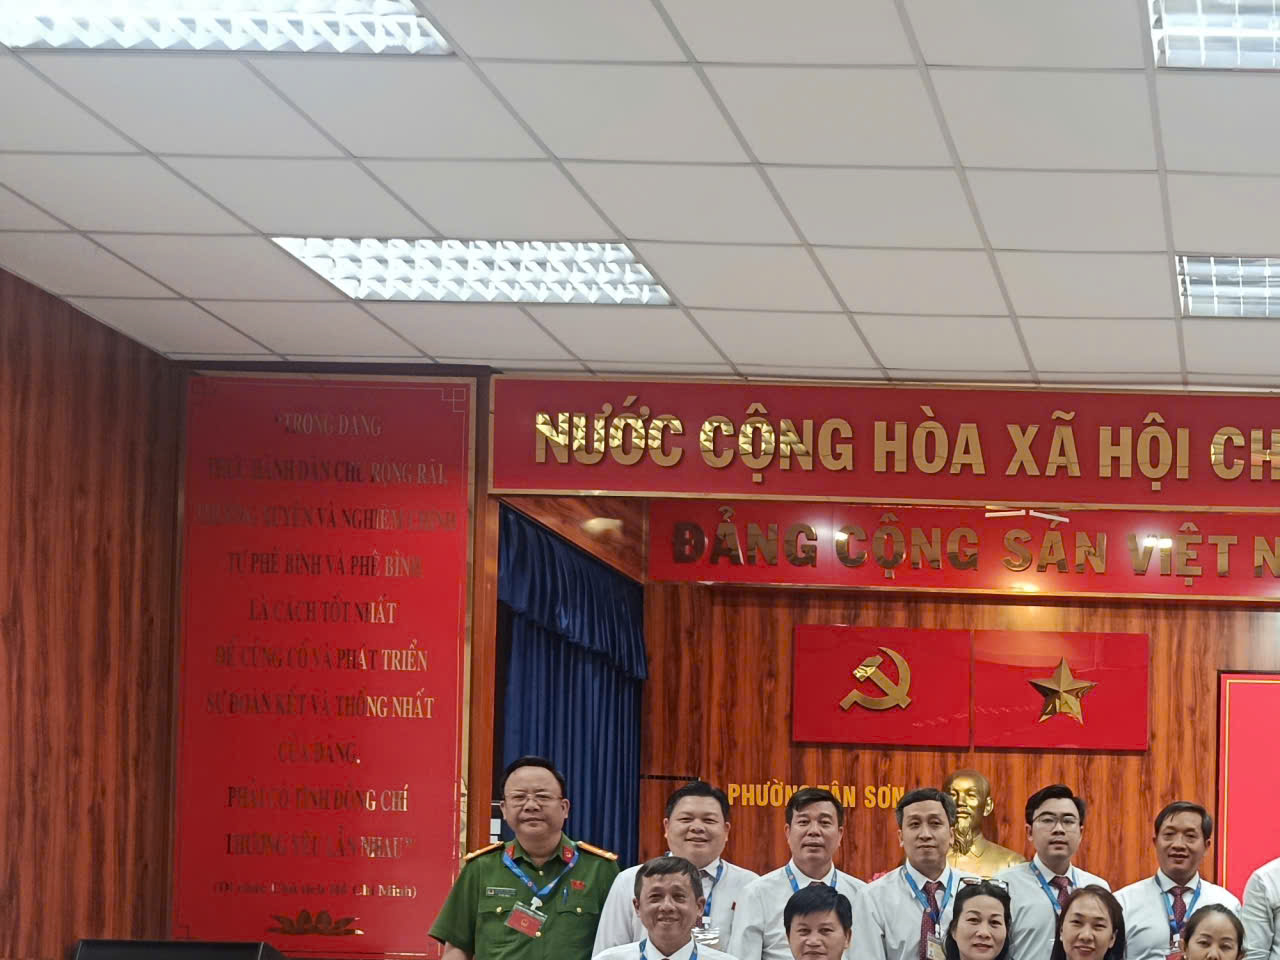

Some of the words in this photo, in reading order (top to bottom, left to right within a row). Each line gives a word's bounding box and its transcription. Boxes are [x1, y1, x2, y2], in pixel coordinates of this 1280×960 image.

[535, 396, 683, 466] NƯỚC
[700, 403, 852, 482] CỘNG
[874, 405, 985, 475] HÒA
[1005, 410, 1081, 477] XÃ
[1099, 412, 1190, 490] HỘI
[672, 506, 817, 568] ĐẢNG
[835, 514, 978, 579] CỘNG
[1128, 522, 1238, 585] VIỆT
[382, 639, 428, 671] TRIỂN
[392, 687, 435, 719] NHẤT
[381, 783, 410, 812] CHÍ
[728, 778, 811, 807] PHƯỜN
